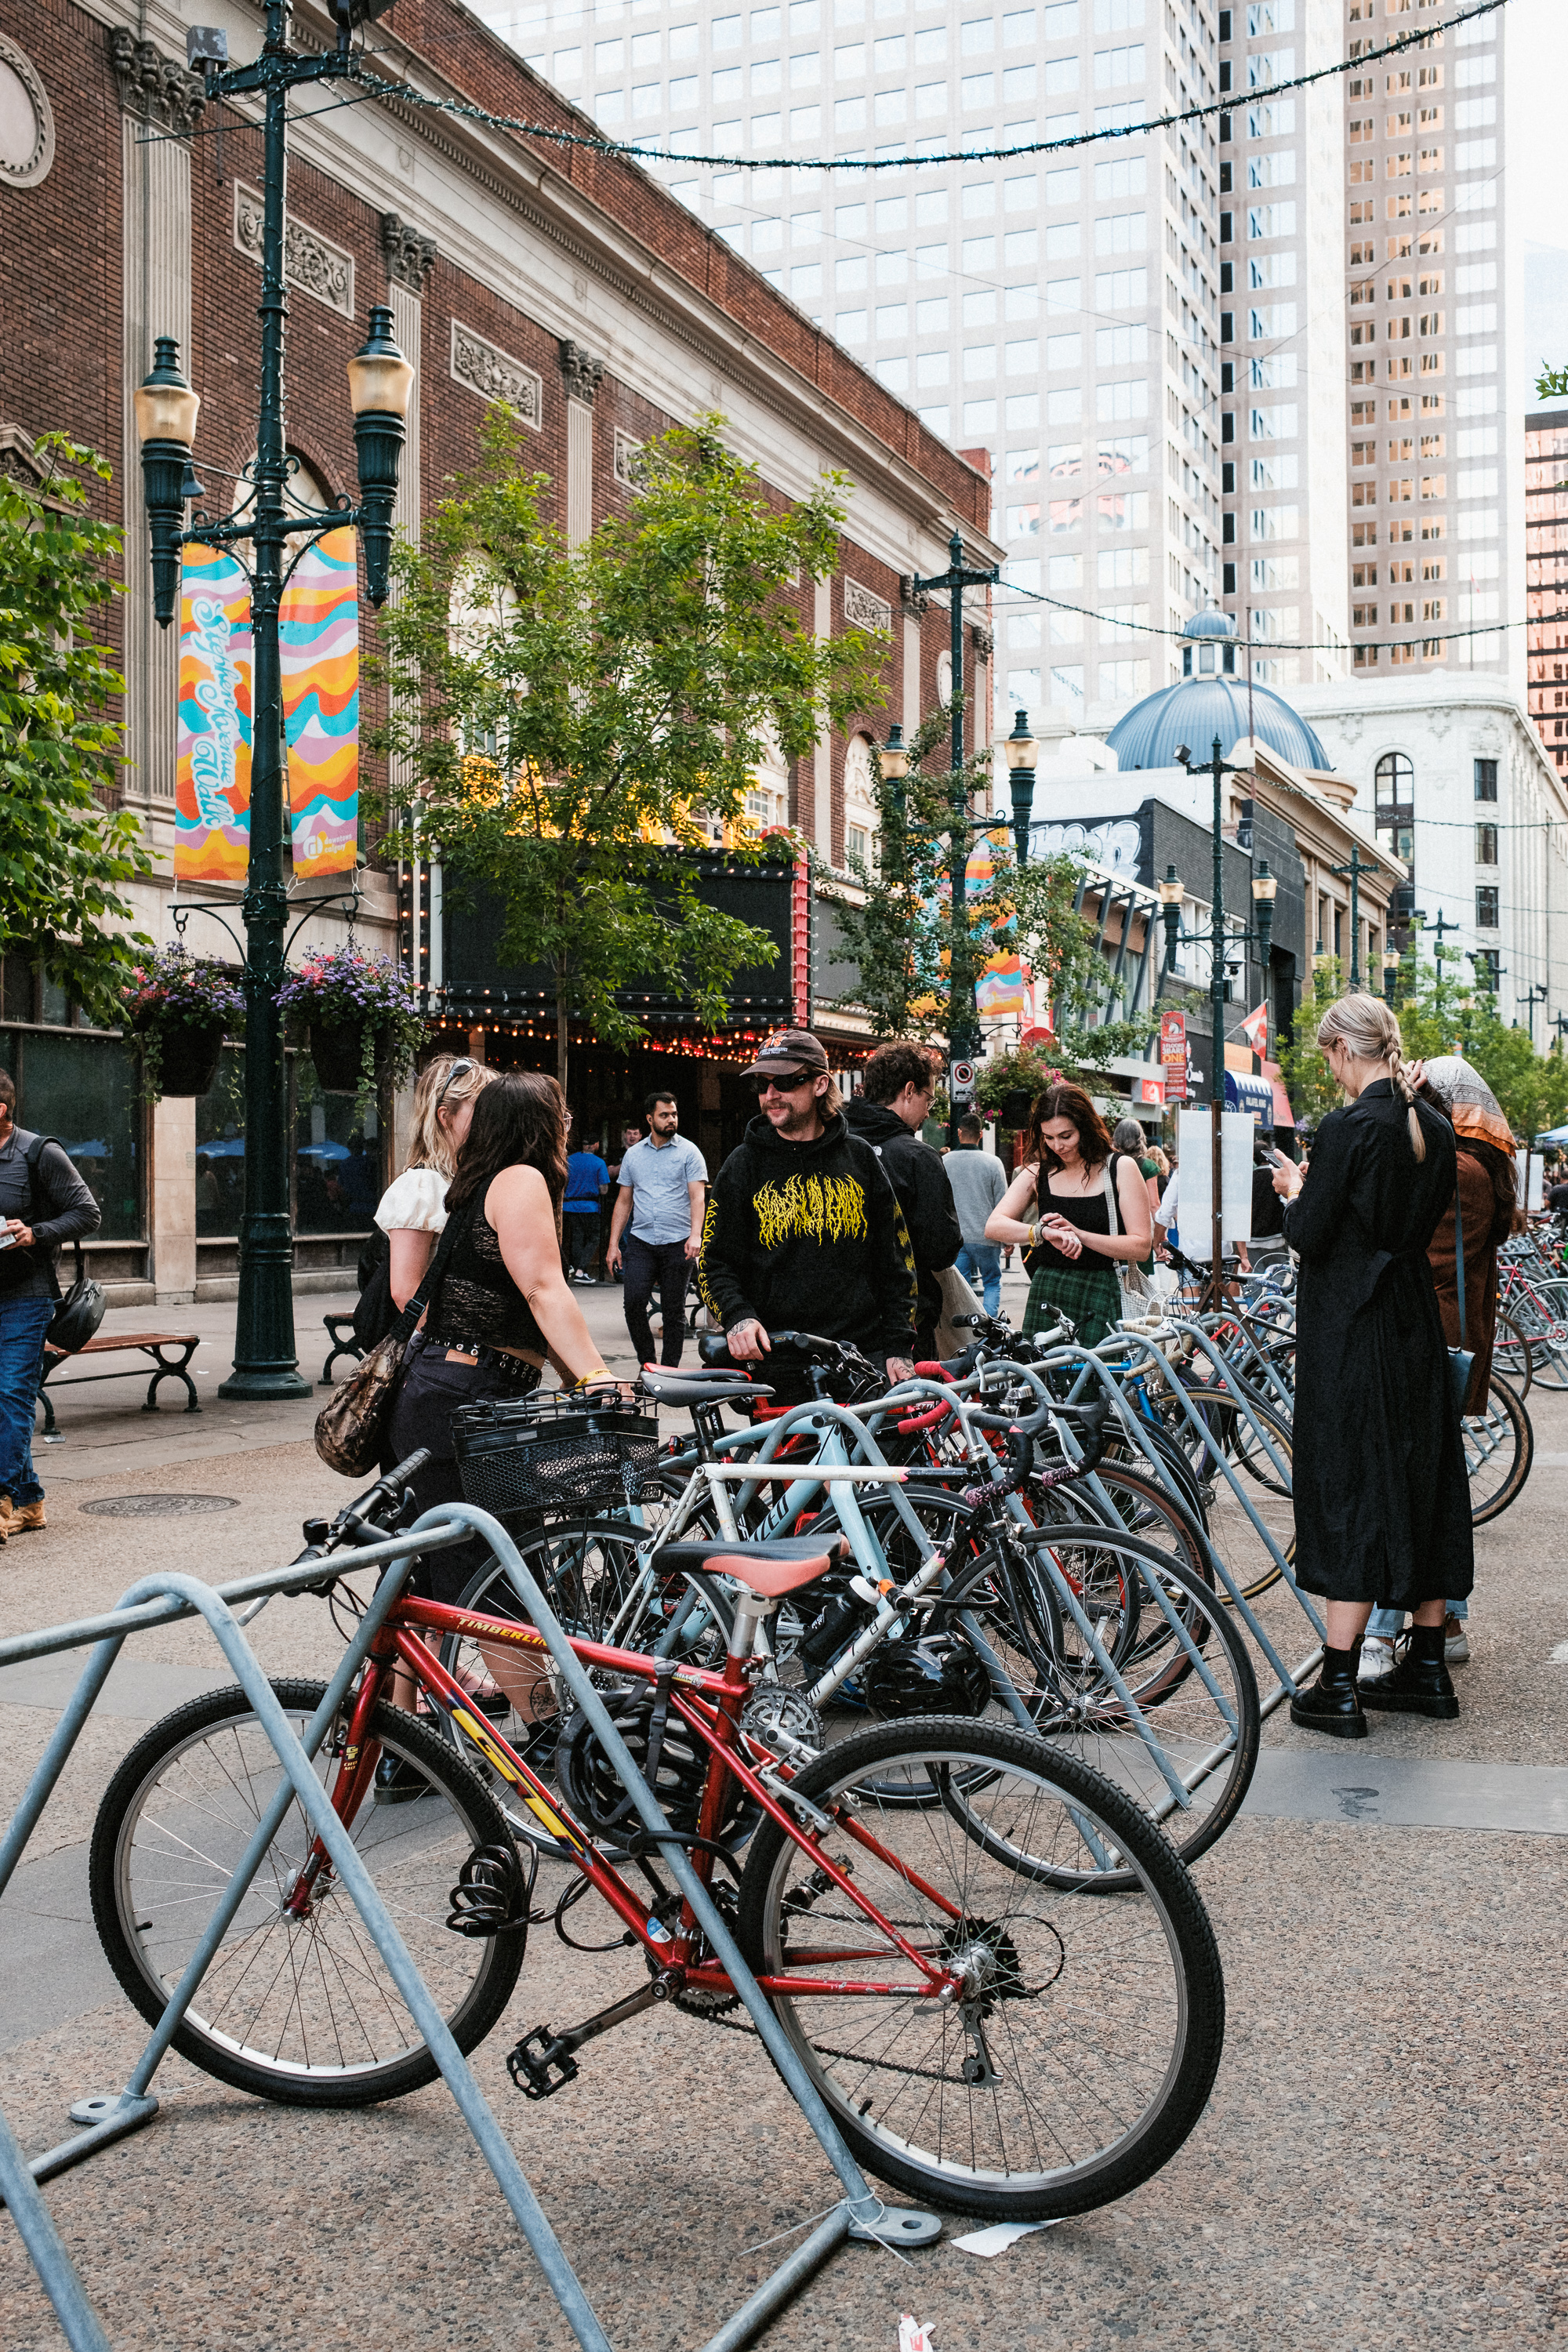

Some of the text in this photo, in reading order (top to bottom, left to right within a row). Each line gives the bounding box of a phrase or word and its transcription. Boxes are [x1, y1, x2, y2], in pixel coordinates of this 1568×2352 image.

[194, 601, 239, 783] Stephen Avenue
[194, 740, 232, 826] Walk
[324, 834, 352, 845] downtown
[324, 844, 346, 854] calgary
[1162, 1054, 1185, 1062] ONE
[459, 1617, 547, 1646] TIMBERLIN
